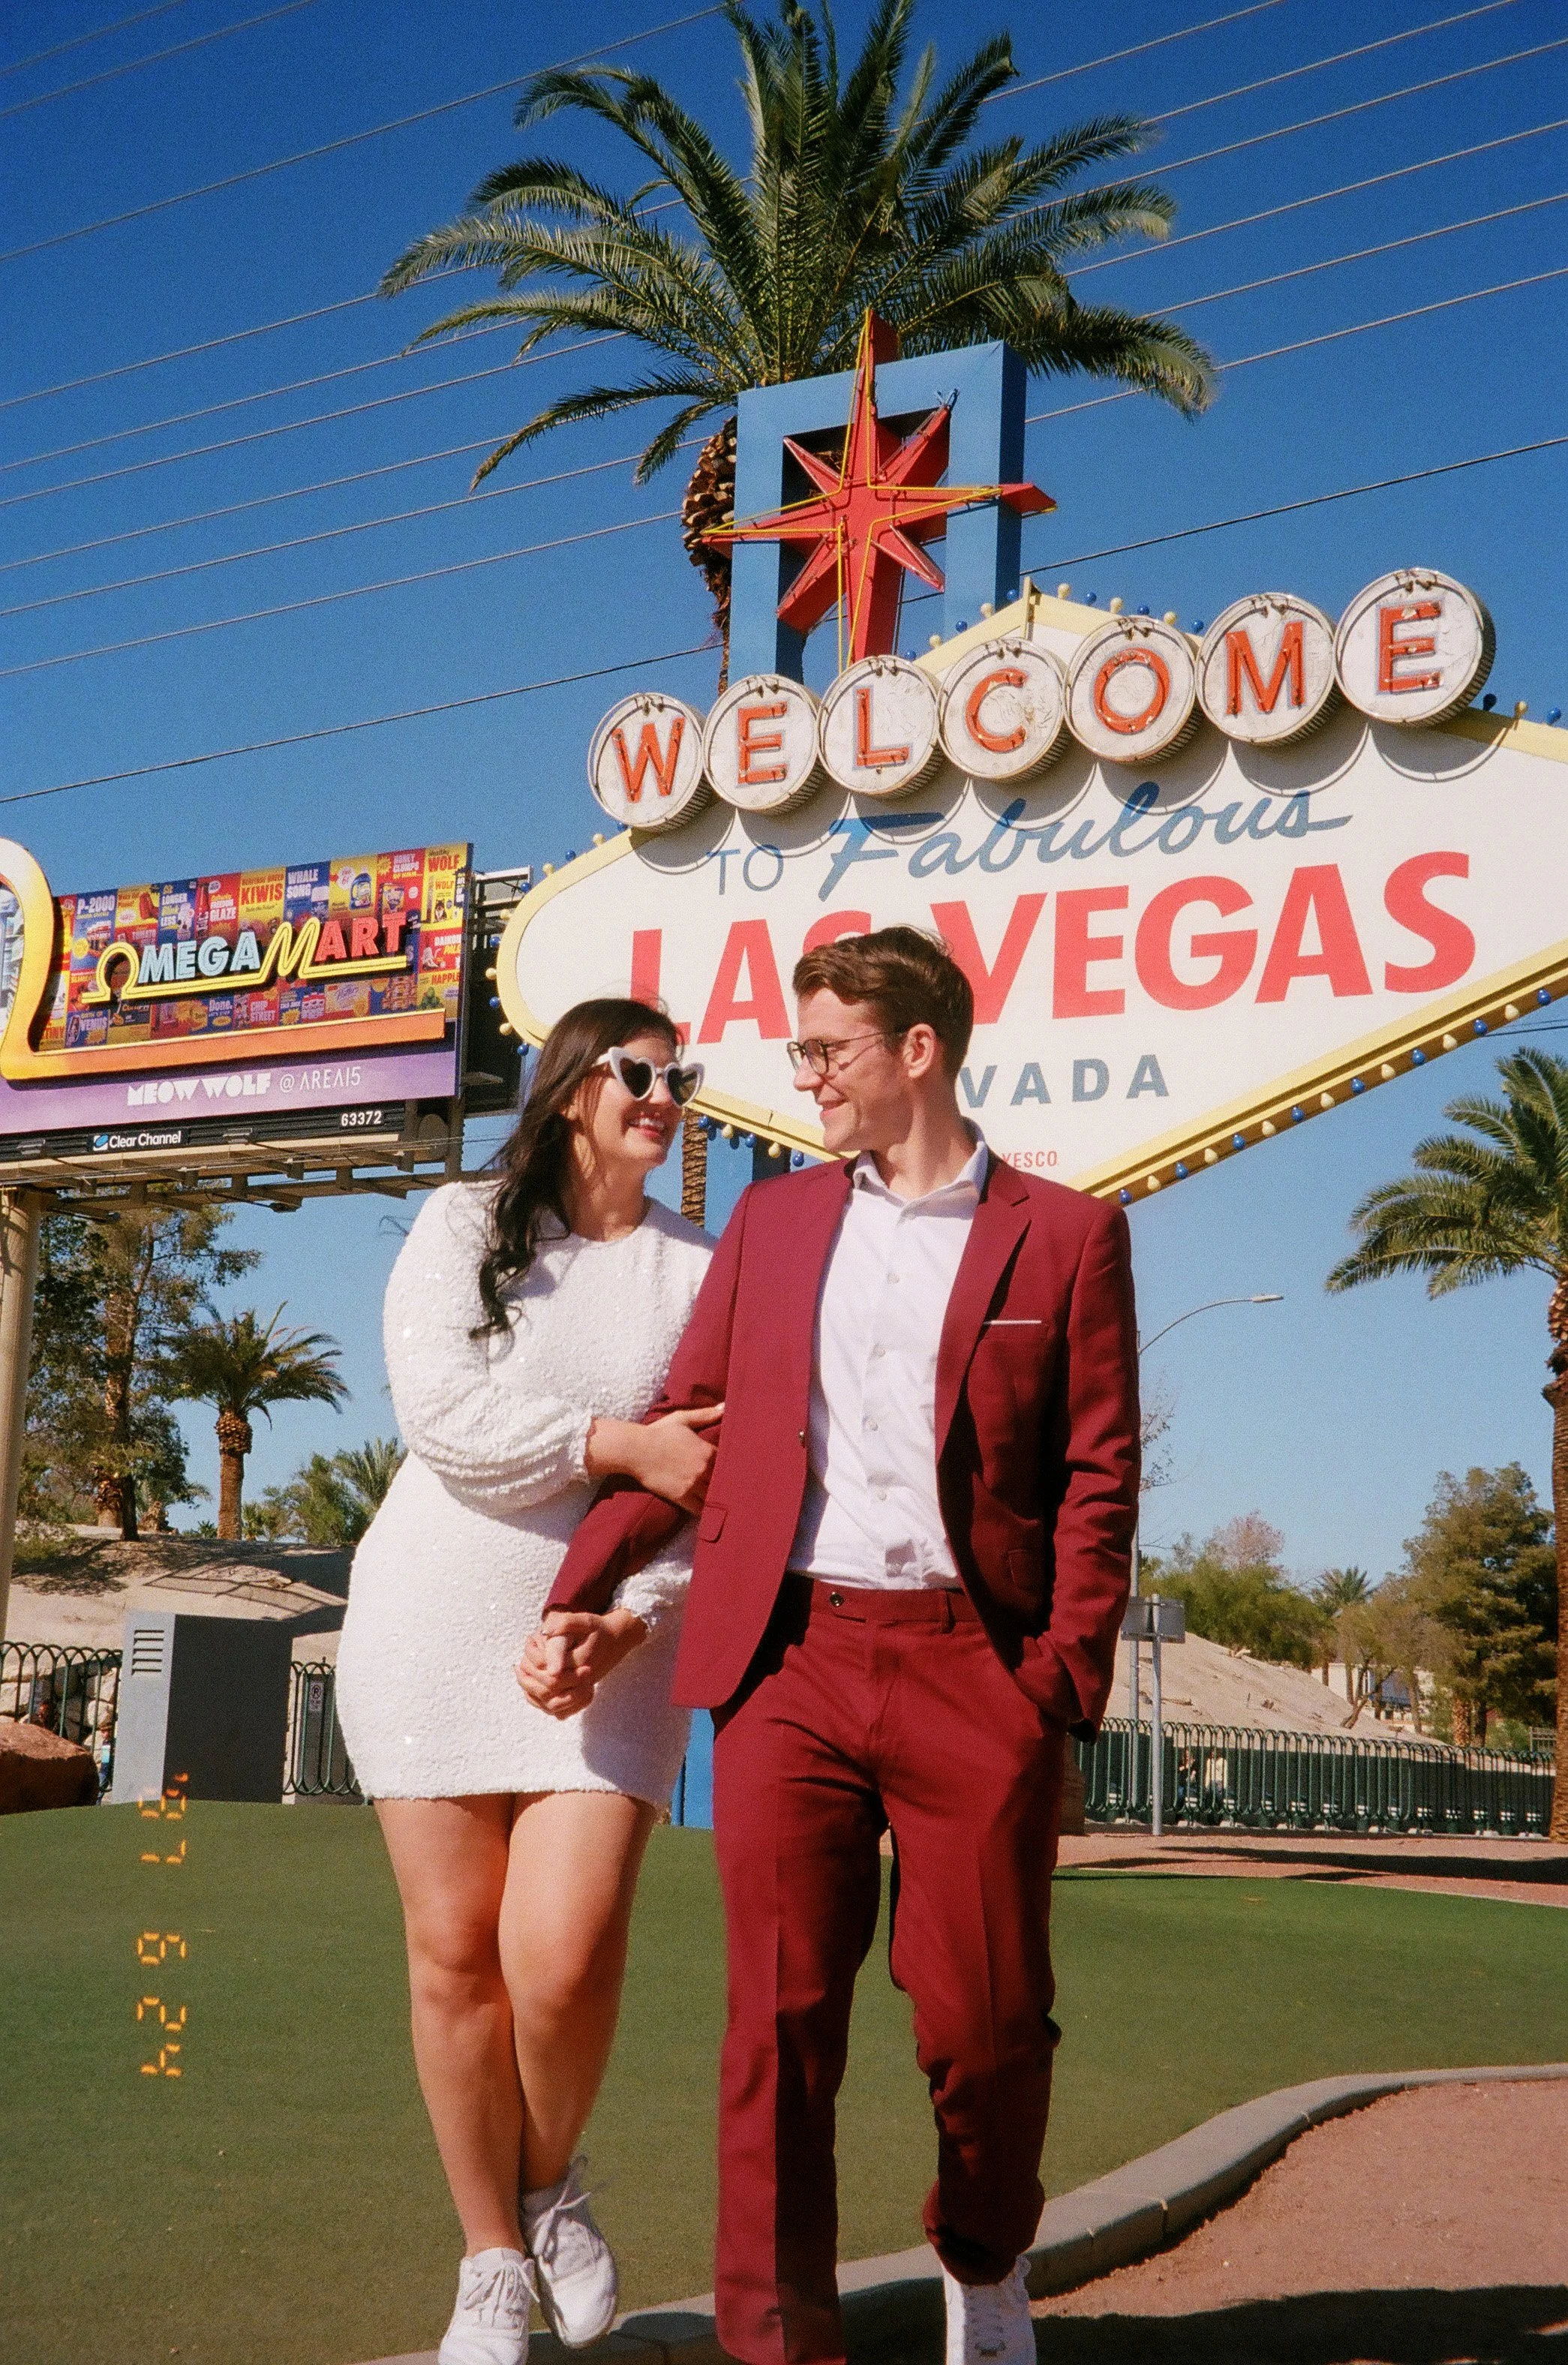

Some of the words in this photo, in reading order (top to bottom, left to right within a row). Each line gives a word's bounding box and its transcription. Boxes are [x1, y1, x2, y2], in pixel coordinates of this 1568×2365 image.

[611, 601, 1441, 804] WELCOME
[706, 844, 784, 895] TO
[818, 781, 1353, 902] Fabulous
[428, 855, 460, 872] WOLF
[288, 868, 319, 885] WHALE
[240, 883, 283, 906] KIWIS
[287, 883, 311, 899] SONG
[77, 895, 116, 915] P-2000
[210, 907, 237, 922] GLAZE
[930, 851, 1476, 1025] VEGAS
[80, 1017, 108, 1032] VENUS
[249, 1010, 276, 1022] STREET
[127, 1079, 200, 1107] MEOW
[202, 1073, 271, 1099] WOLF
[281, 1074, 295, 1094] @
[959, 1054, 1170, 1108] VADA
[341, 1110, 382, 1126] 63372
[109, 1134, 137, 1149] Clear
[138, 1131, 182, 1146] Channel
[1002, 1150, 1058, 1168] YESCO
